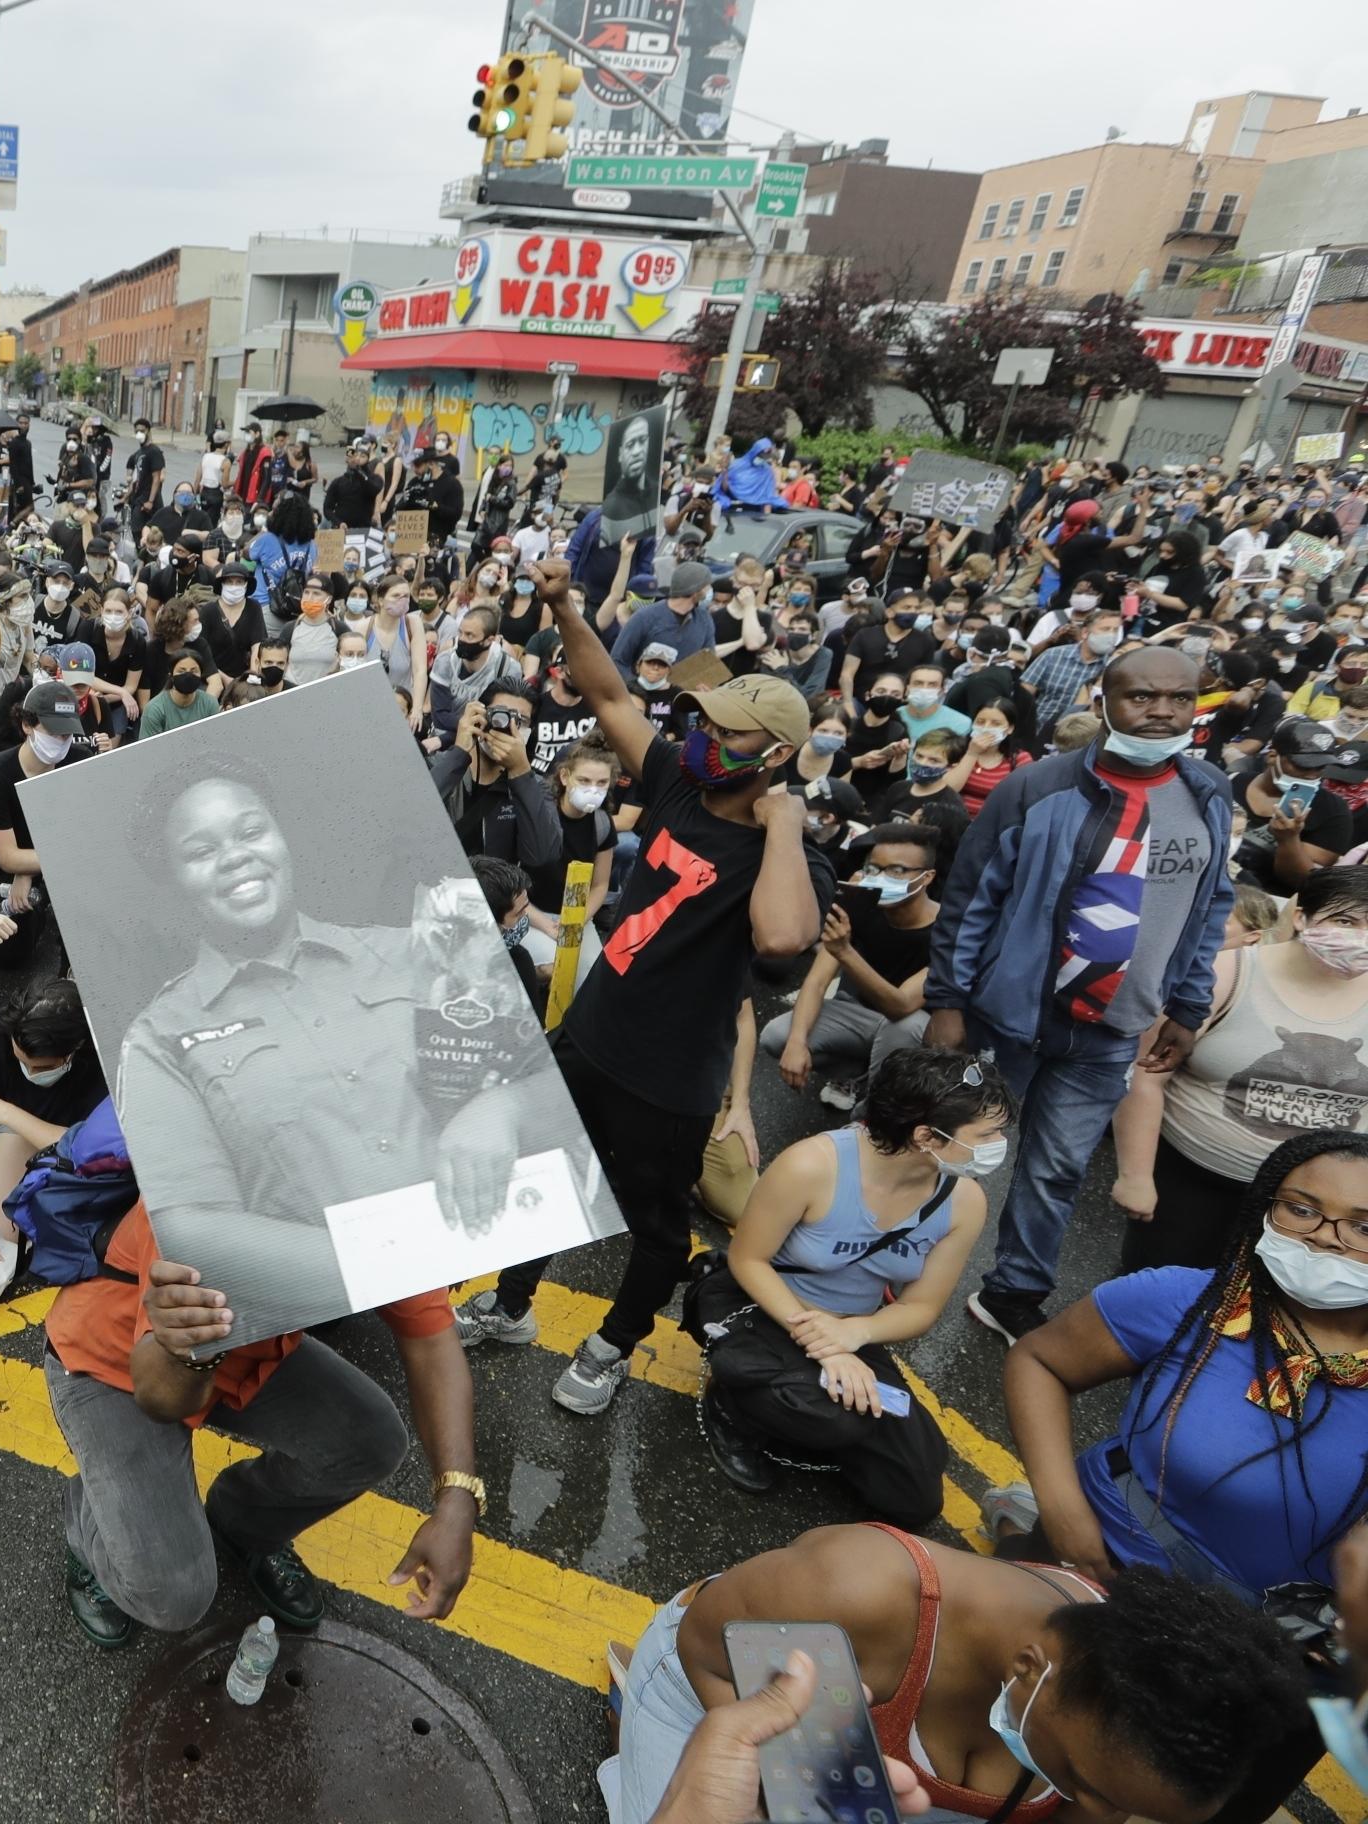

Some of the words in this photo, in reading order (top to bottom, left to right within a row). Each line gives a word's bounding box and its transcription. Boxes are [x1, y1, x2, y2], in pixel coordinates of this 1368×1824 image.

[587, 23, 670, 54] A10
[575, 163, 711, 187] Washington
[719, 166, 748, 182] Av
[764, 168, 803, 184] Brooklyn
[761, 184, 799, 197] Museum
[518, 235, 603, 279] CAR
[500, 278, 611, 321] WASH
[525, 320, 549, 332] OIL
[551, 322, 612, 335] CHANGE
[1185, 332, 1274, 368] LUBE
[398, 513, 426, 522] BLACK
[398, 522, 425, 531] LIVES
[398, 533, 424, 541] MATTER
[832, 1240, 910, 1258] PUA
